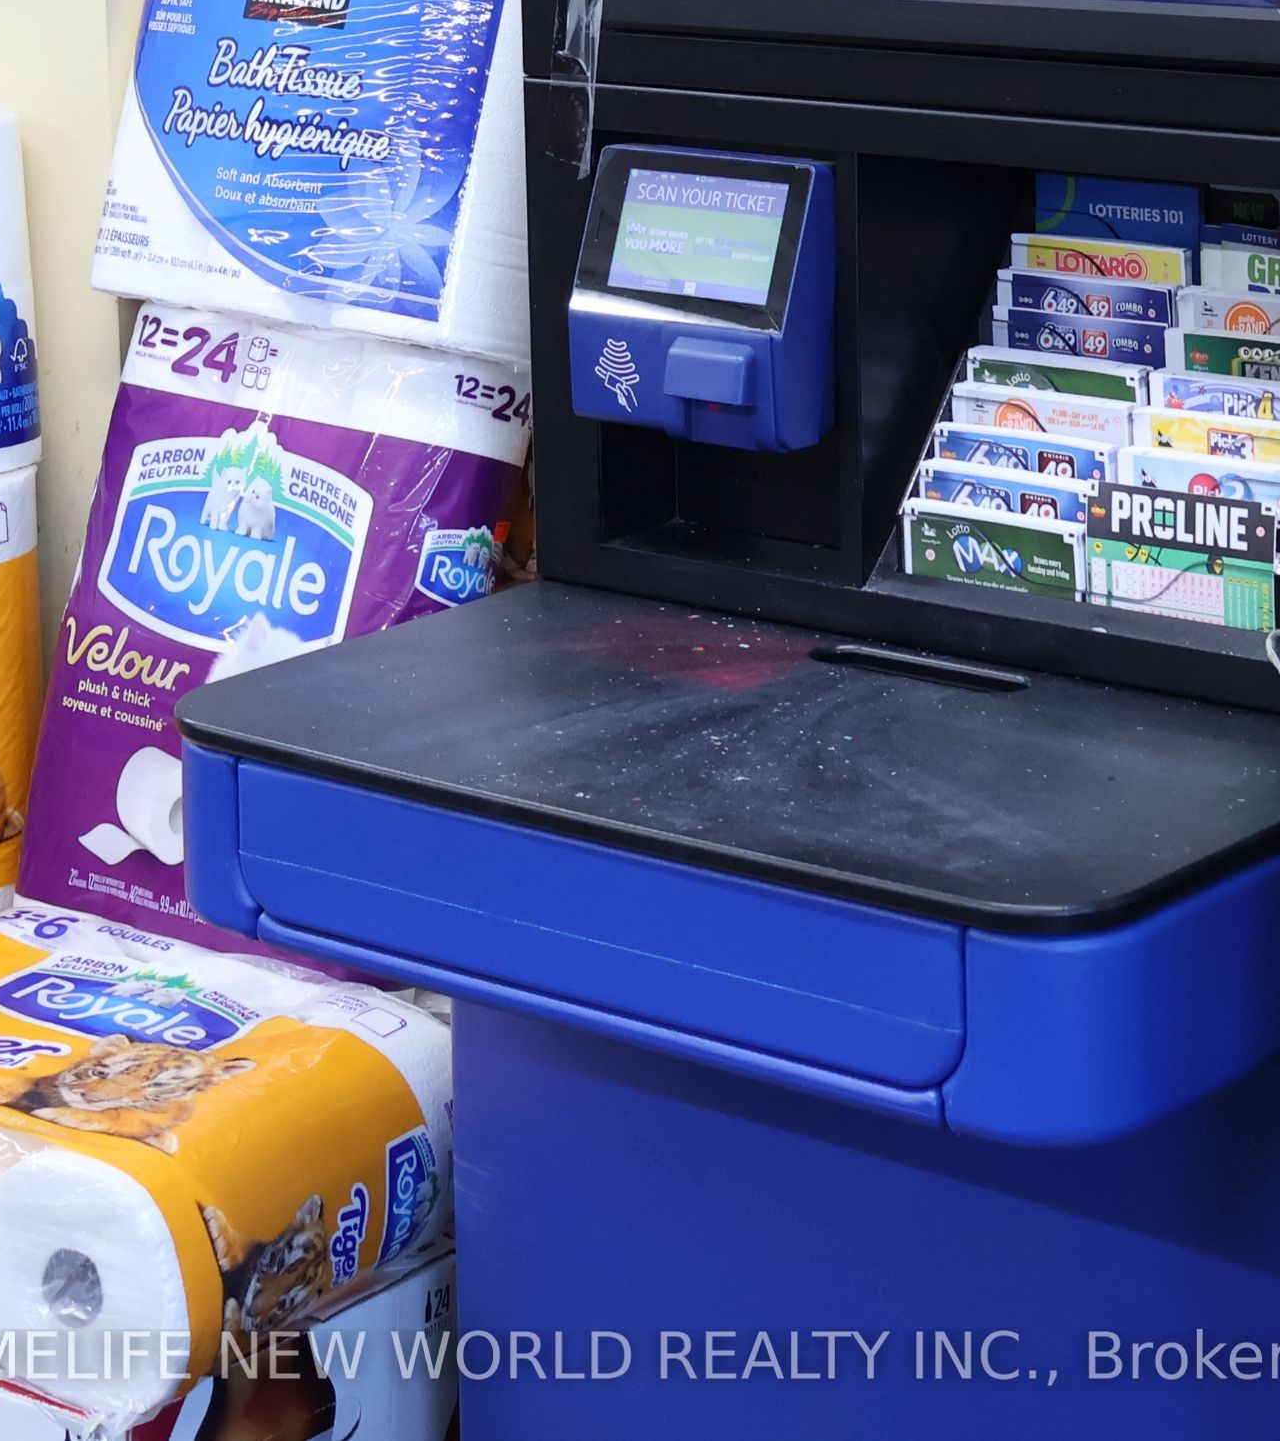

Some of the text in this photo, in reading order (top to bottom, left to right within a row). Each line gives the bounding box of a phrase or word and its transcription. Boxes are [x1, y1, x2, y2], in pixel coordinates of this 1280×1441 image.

[208, 37, 362, 100] Bath Tissue
[162, 89, 243, 144] Papier
[216, 167, 322, 195] Soft and Absorbent
[215, 185, 316, 213] Doux et absorbant
[637, 183, 776, 212] SCAN YOUR TICKET
[1089, 203, 1184, 225] LOTTERIES 101
[1242, 233, 1278, 246] LOTTERY
[1055, 251, 1144, 279] LOTTARIO
[1085, 335, 1105, 353] 49
[1112, 338, 1138, 351] COMBO
[1224, 392, 1256, 418] Pick
[141, 447, 206, 467] CARBON
[138, 463, 200, 481] NEUTRAL
[947, 524, 970, 540] Lotto
[126, 502, 328, 617] Royale
[65, 617, 191, 691] Velour
[78, 677, 152, 707] plush & thick
[62, 694, 164, 732] soyeux et coussiné
